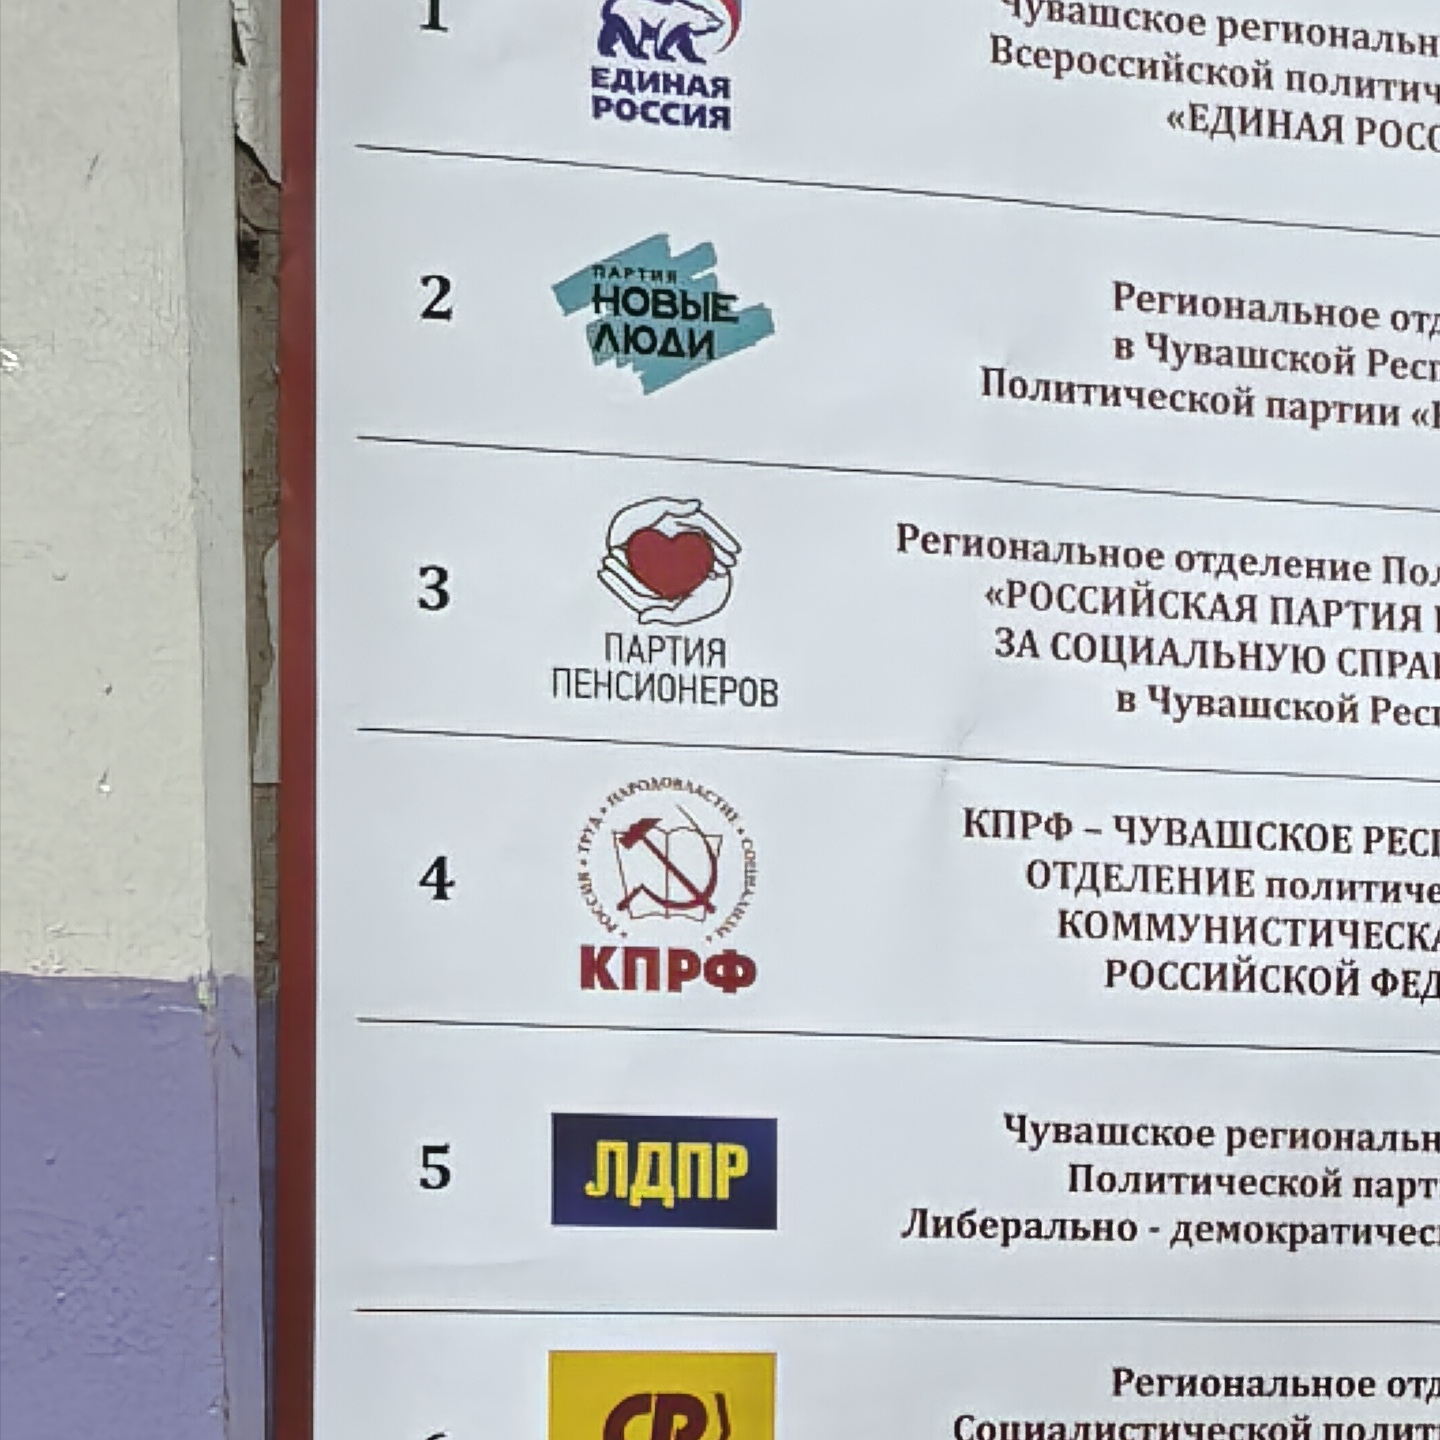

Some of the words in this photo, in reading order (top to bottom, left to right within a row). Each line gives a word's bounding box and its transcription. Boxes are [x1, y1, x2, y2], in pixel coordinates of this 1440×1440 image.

[591, 65, 731, 99] ЕДИНАЯ
[989, 31, 1275, 91] Всероссийской
[592, 95, 731, 131] РОССИЯ
[1166, 100, 1345, 145] «ЕДИНАЯ
[592, 264, 677, 285] ПАРТИЯ
[419, 274, 455, 323] 2
[592, 283, 739, 323] НОВЫЕ
[1112, 280, 1381, 331] Региональное
[593, 323, 714, 360] ЛЮДИ
[1112, 335, 1135, 361] в
[1145, 330, 1357, 377] Чувашской
[979, 365, 1256, 418] Политической
[1265, 395, 1402, 431] партии
[896, 521, 1165, 571] Региональное
[1175, 548, 1372, 583] отделение
[416, 564, 451, 612] 3
[984, 577, 1258, 625] «РОССИЙСКАЯ
[1269, 594, 1424, 633] ПАРТИЯ
[604, 632, 726, 669] ПАРТИЯ
[995, 626, 1042, 660] ЗА
[1049, 630, 1326, 675] СОЦИАЛЬНУЮ
[552, 667, 779, 707] ПЕНСИОНЕРОВ
[1115, 689, 1138, 713] в
[1145, 684, 1359, 724] Чувашской
[962, 806, 1074, 842] КПРФ
[1112, 814, 1354, 855] ЧУВАШСКОЕ
[417, 855, 456, 901] 4
[1025, 858, 1255, 899] ОТДЕЛЕНИЕ
[580, 944, 757, 994] КПРФ
[1104, 954, 1362, 999] РОССИЙСКОЙ
[1003, 1112, 1217, 1153] Чувашское
[419, 1142, 451, 1190] 5
[585, 1140, 748, 1208] ЛДПР
[1067, 1161, 1343, 1199] Политической
[900, 1207, 1138, 1249] Либерально
[1111, 1365, 1378, 1401] Региональное
